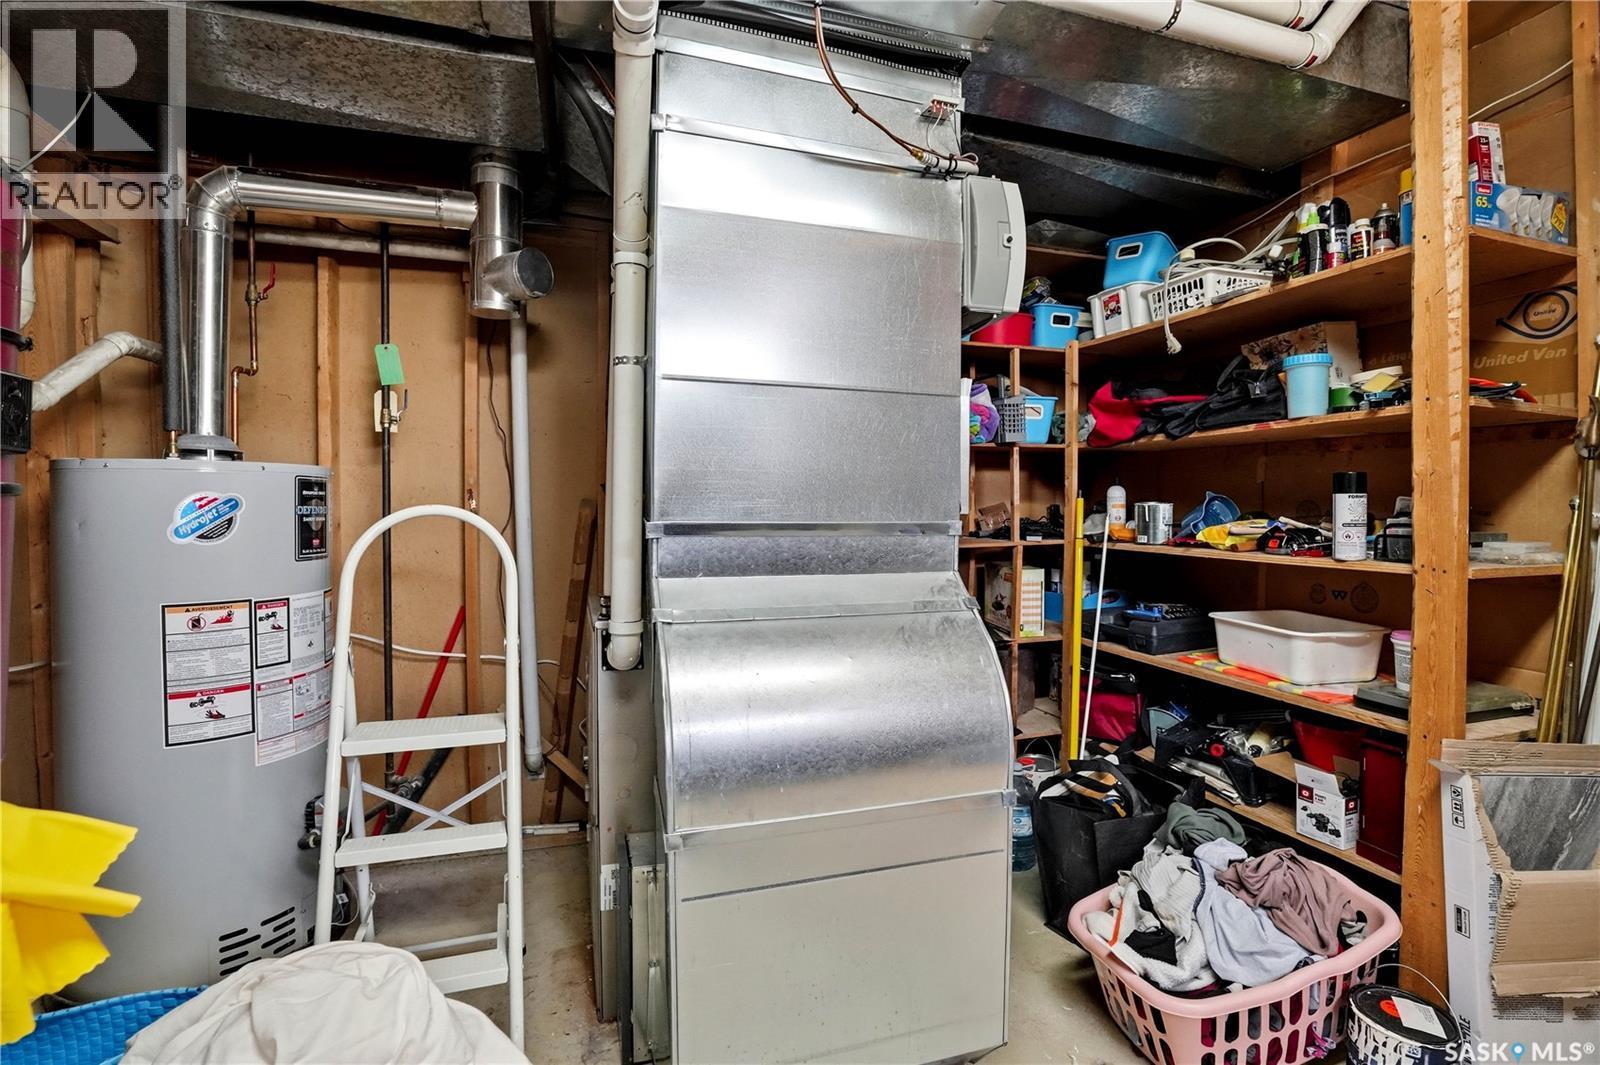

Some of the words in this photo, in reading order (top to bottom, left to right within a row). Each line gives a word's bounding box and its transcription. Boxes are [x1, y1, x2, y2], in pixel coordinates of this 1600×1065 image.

[1473, 351, 1528, 368] United
[1533, 347, 1567, 362] Van
[178, 508, 219, 536] Hydrojet
